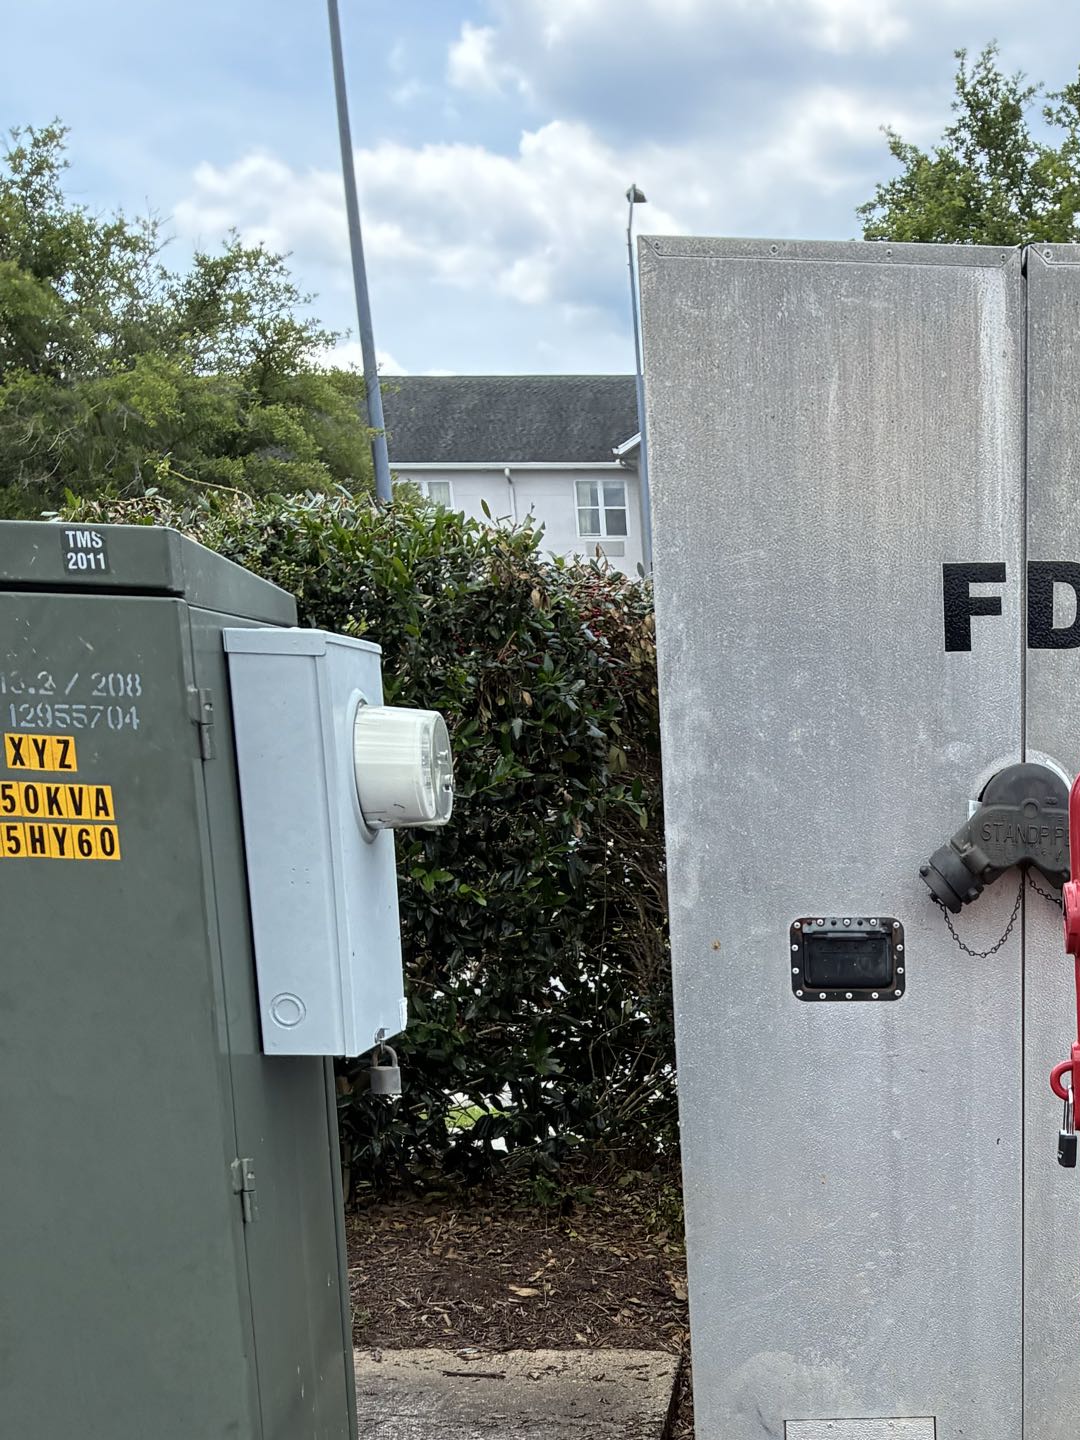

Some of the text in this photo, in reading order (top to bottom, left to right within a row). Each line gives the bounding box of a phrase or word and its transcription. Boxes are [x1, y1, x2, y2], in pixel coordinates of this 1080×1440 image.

[65, 531, 103, 548] TMS
[67, 552, 105, 570] 2011
[91, 672, 142, 697] 208
[9, 736, 72, 769] XYZ
[1, 783, 110, 817] 50KVA
[5, 825, 115, 857] 5HY60
